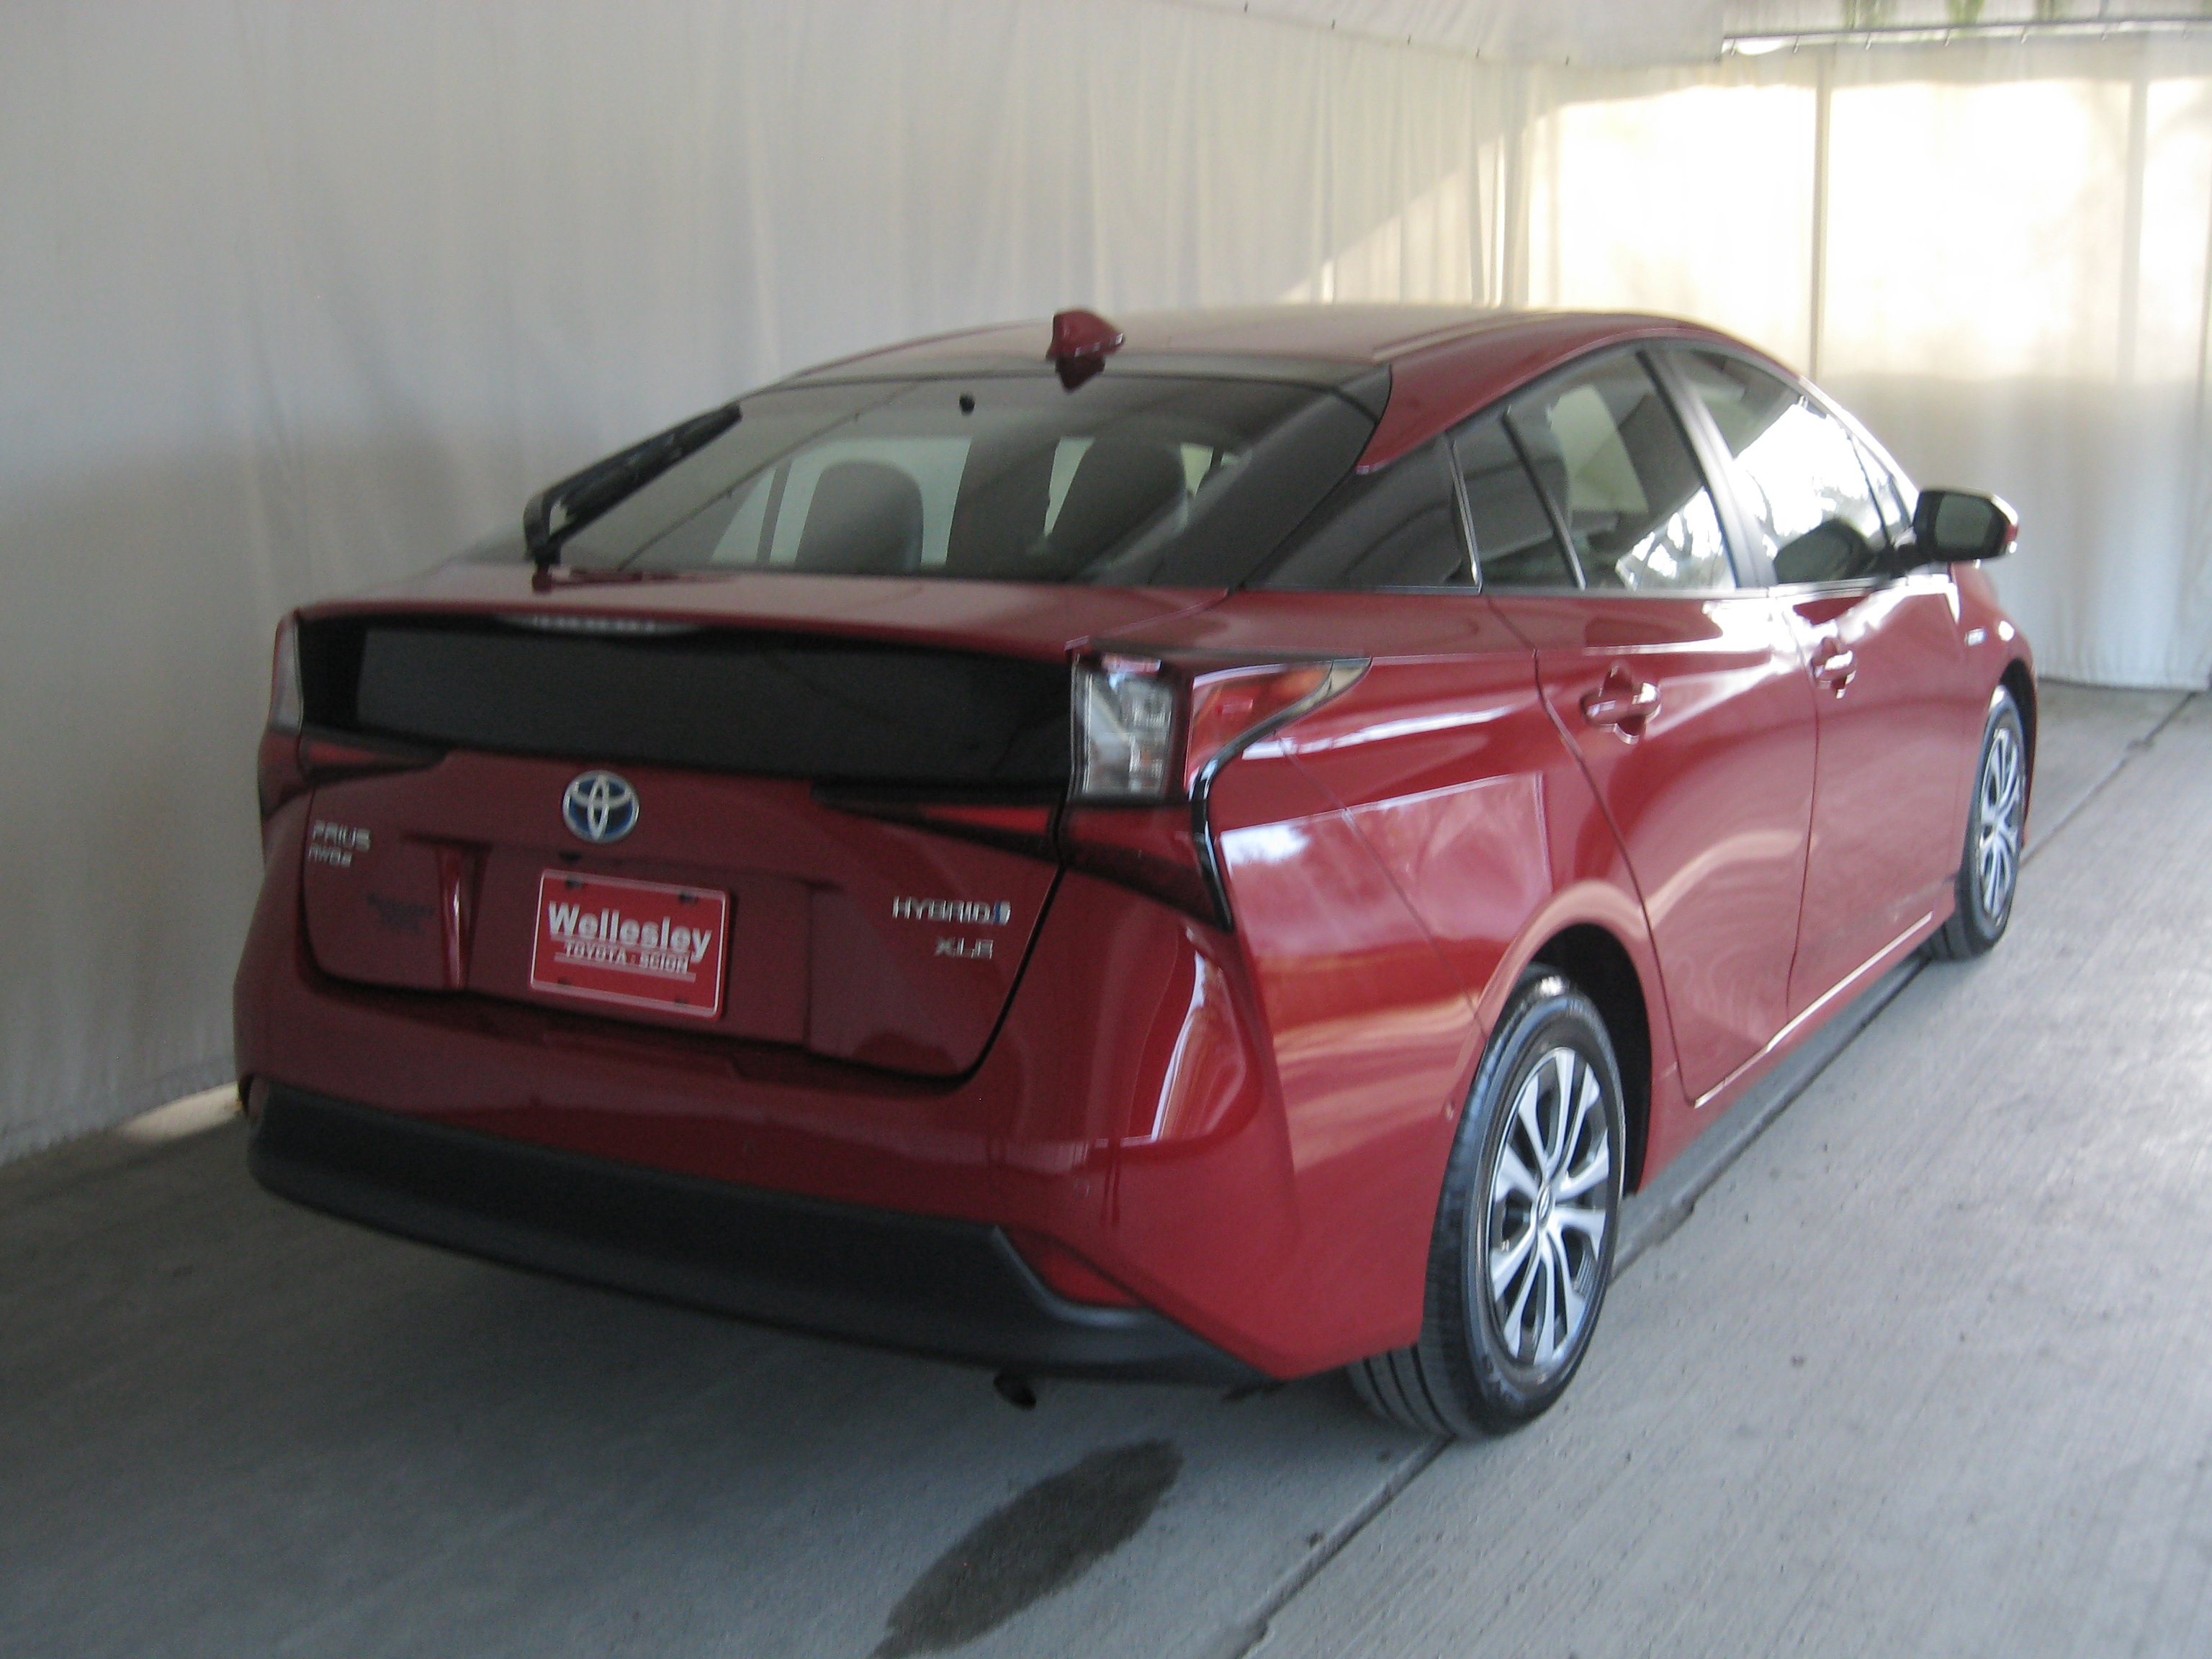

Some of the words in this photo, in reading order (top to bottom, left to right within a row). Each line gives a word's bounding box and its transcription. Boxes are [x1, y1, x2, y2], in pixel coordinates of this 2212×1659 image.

[313, 820, 371, 852] PRIUS
[892, 896, 991, 923] HYBRID
[549, 902, 711, 963] Wellesley
[565, 940, 627, 963] TOYOTA
